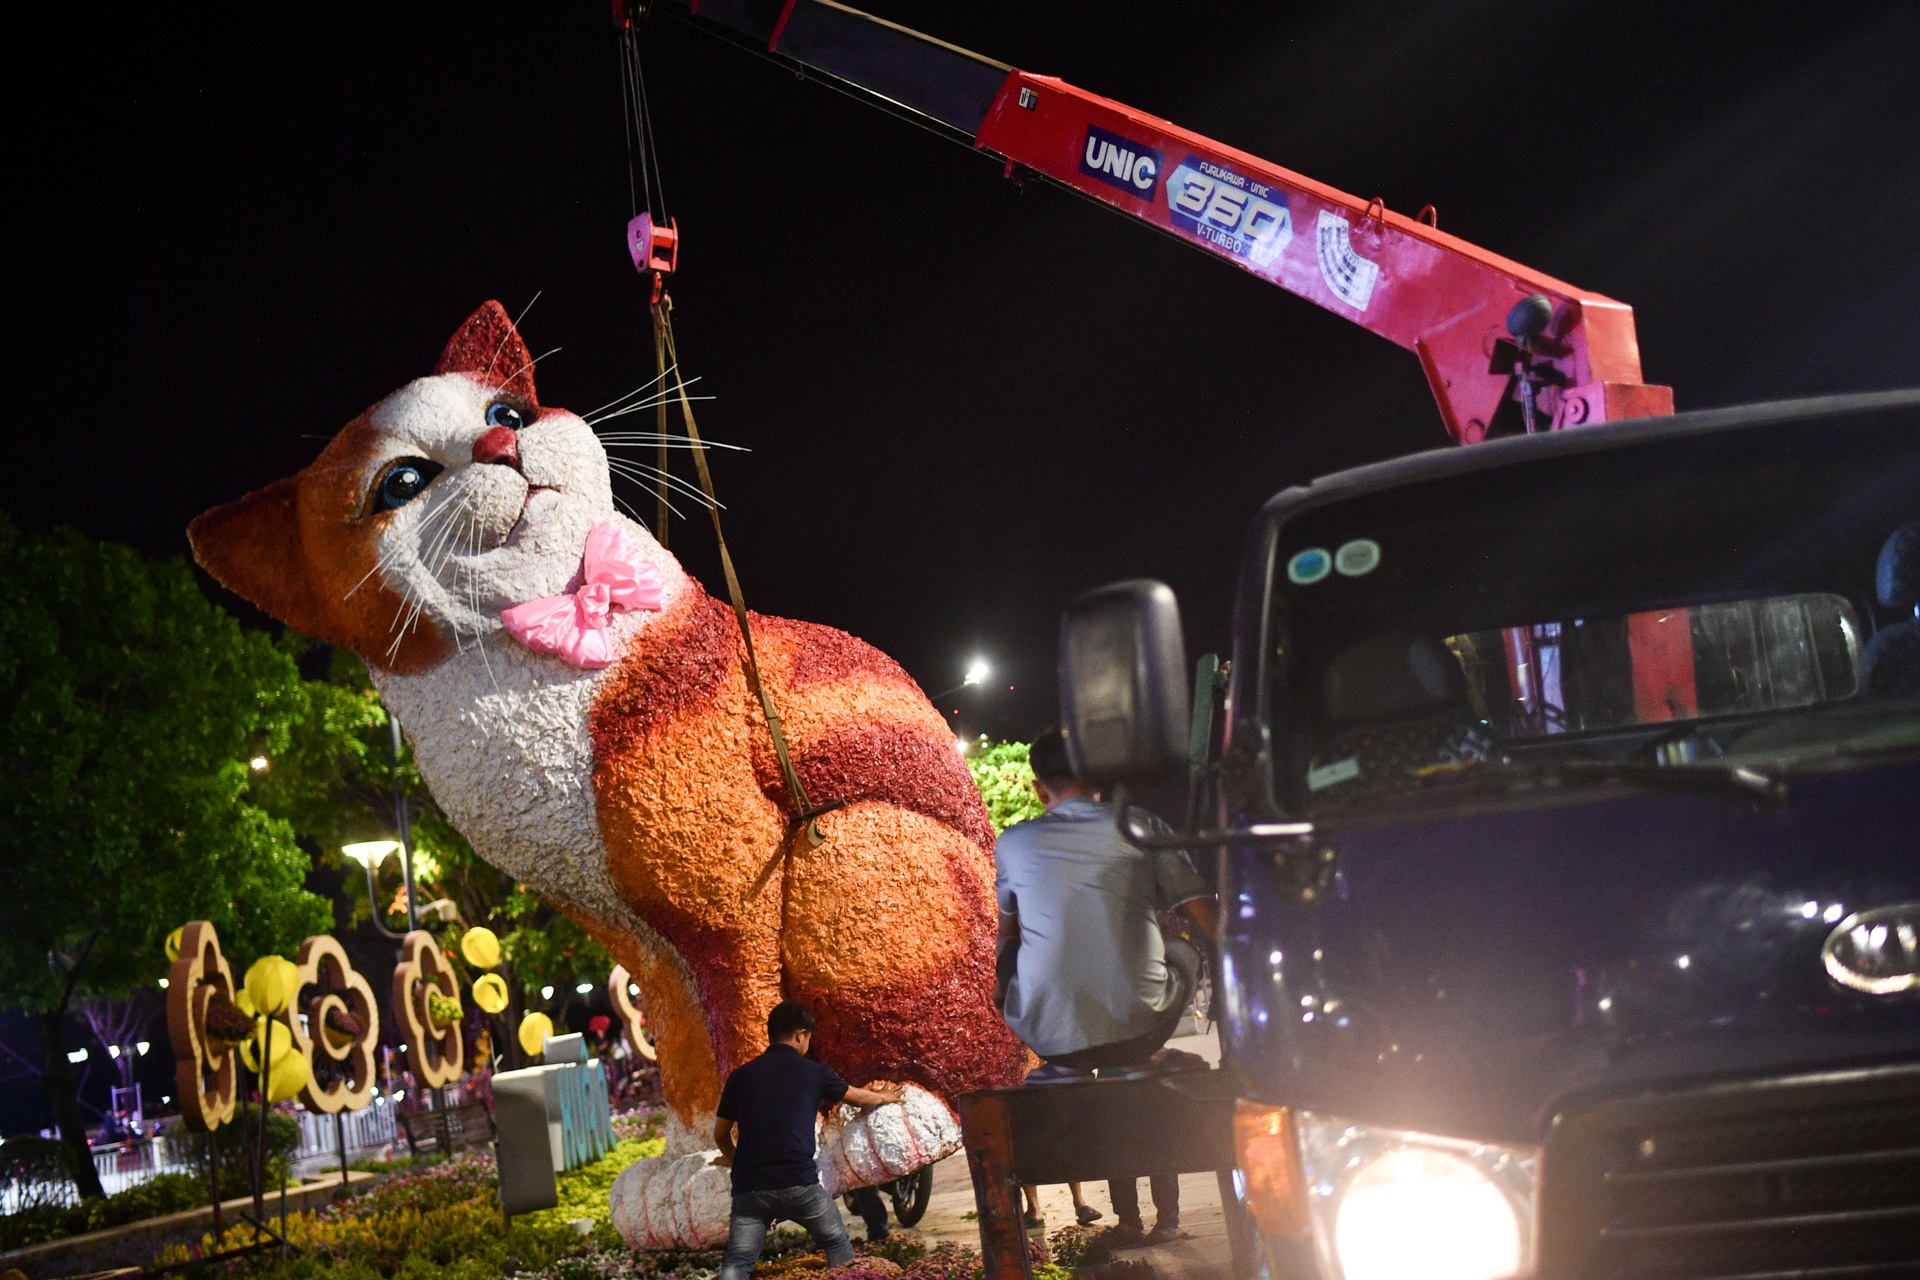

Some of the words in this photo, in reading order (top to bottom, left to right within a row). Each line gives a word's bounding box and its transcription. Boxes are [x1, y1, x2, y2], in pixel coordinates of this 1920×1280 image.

[1085, 136, 1156, 190] UNIC
[1200, 161, 1245, 188] FURUKAWA
[1250, 182, 1270, 198] UNIC
[1175, 172, 1285, 243] 360
[1196, 223, 1242, 253] V-TURBO
